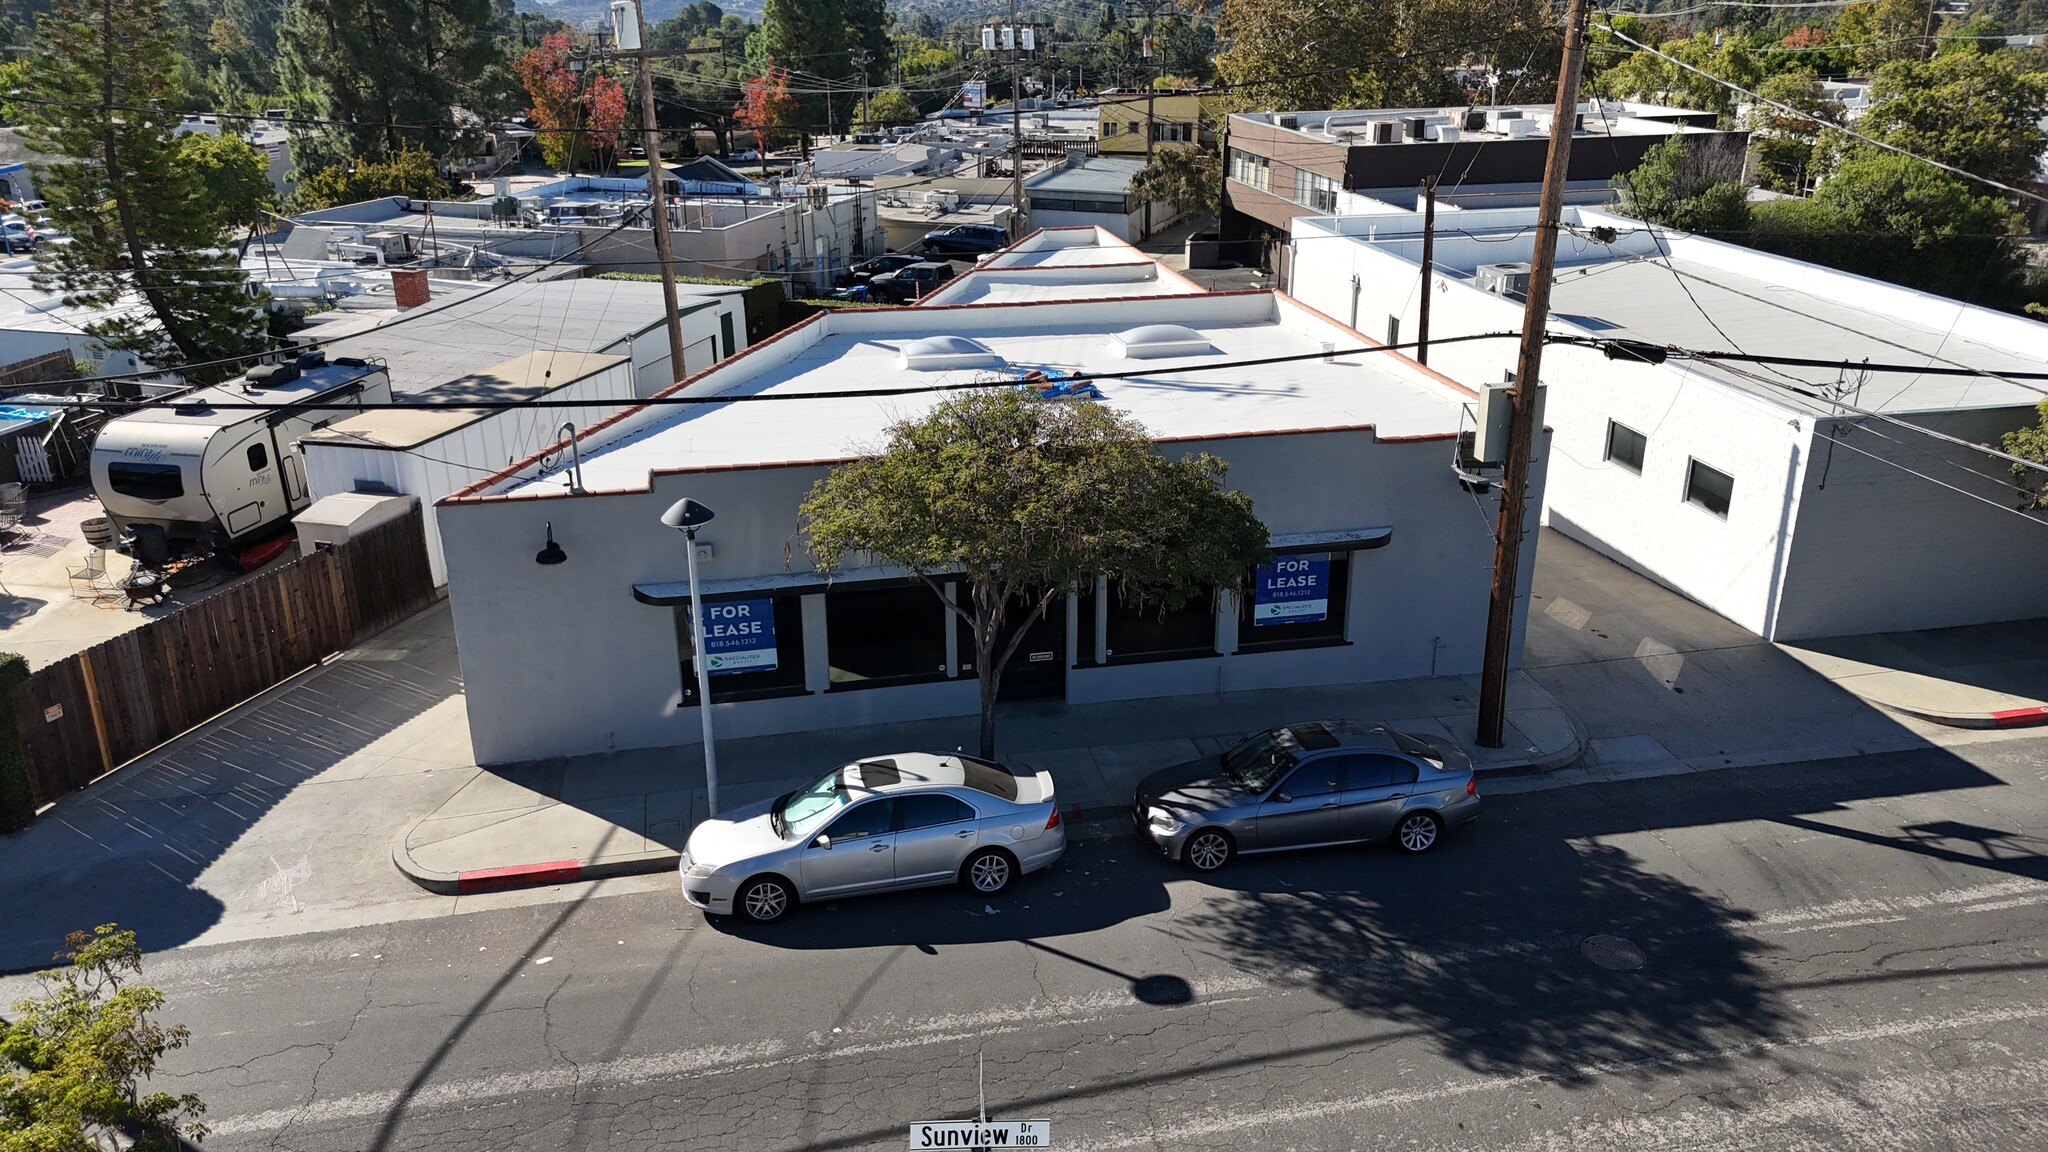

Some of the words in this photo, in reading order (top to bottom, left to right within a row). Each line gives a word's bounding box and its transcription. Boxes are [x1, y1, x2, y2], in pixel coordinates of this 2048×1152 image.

[1277, 560, 1309, 573] FOR
[1267, 575, 1317, 589] LEASE
[710, 605, 750, 619] FOR
[703, 622, 762, 638] LEASE
[711, 638, 756, 648] 818.546.1212
[921, 1125, 1008, 1147] Sunview
[1021, 1123, 1032, 1133] Dr
[1015, 1135, 1038, 1145] 1800
